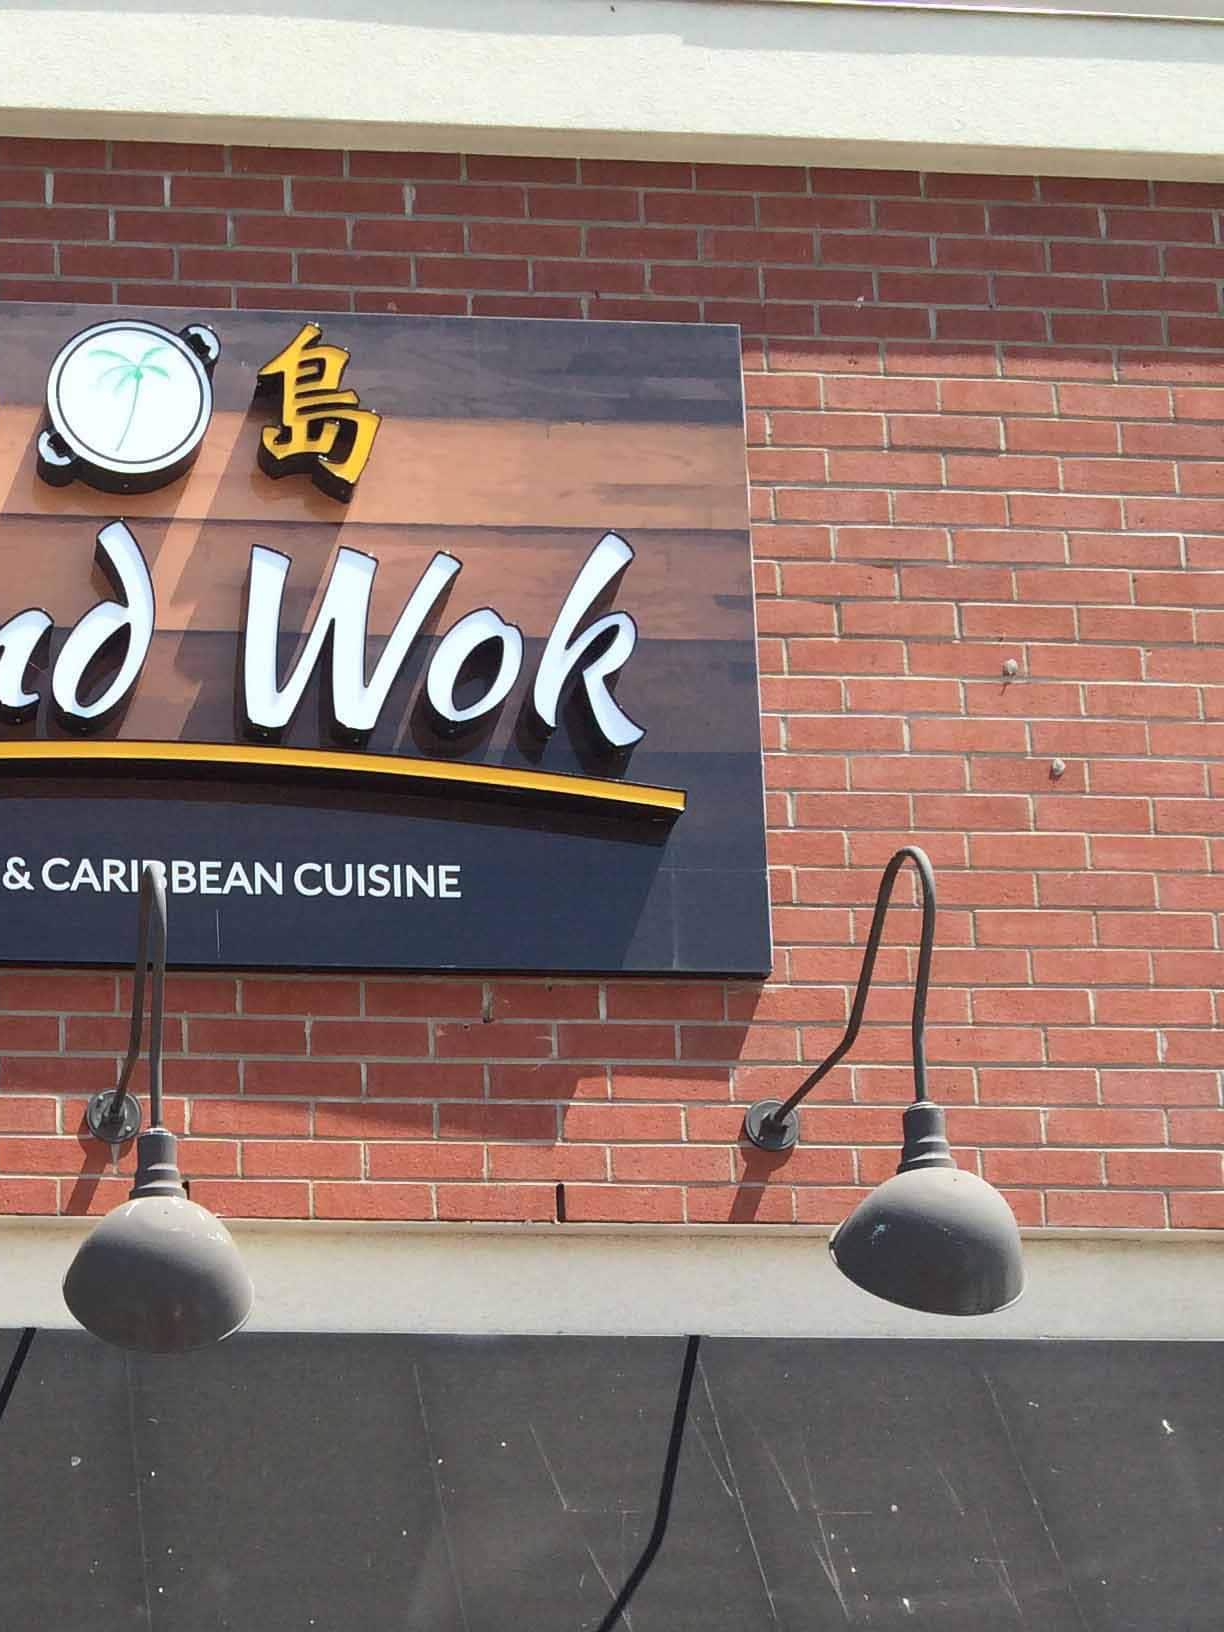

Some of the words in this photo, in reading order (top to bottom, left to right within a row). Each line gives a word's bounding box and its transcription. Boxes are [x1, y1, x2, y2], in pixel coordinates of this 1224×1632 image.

[258, 322, 382, 490] 島
[244, 531, 648, 748] Wok
[2, 856, 35, 890] &
[293, 861, 463, 898] CUISINE
